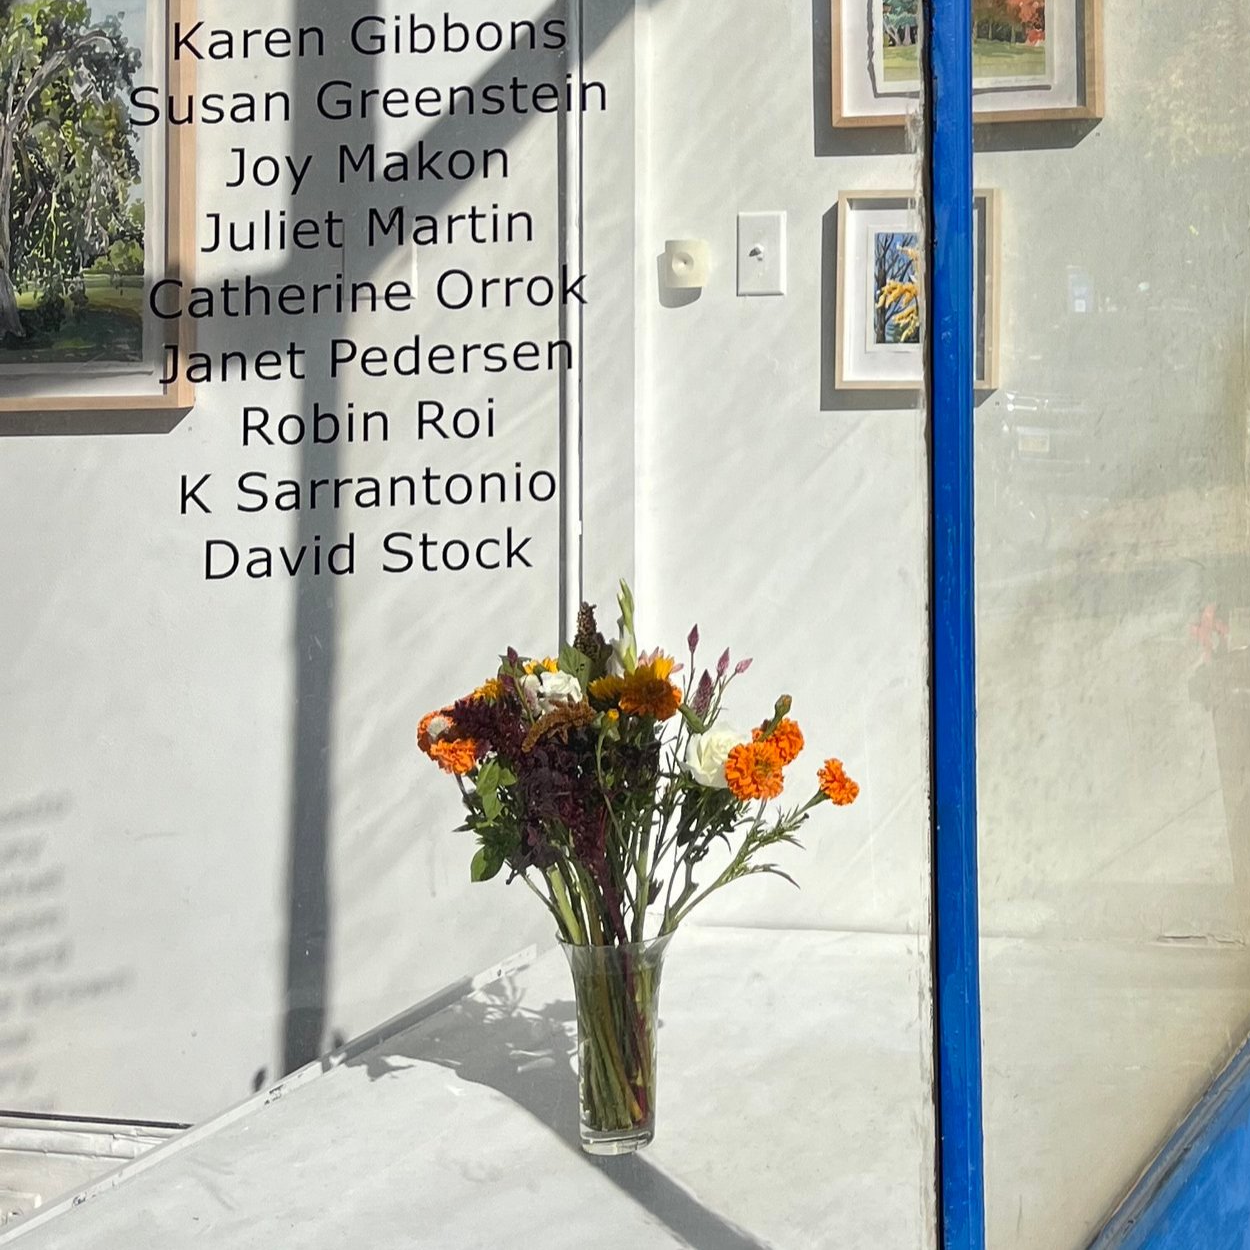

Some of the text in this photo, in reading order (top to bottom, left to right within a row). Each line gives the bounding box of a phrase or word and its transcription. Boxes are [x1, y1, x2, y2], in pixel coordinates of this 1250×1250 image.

[174, 13, 566, 60] Karen Gibbons
[129, 74, 606, 126] Susan Greenstein
[226, 140, 508, 196] Joy Makon
[201, 205, 532, 252] Juliet Martin
[149, 264, 588, 320] Catherine Orrok
[159, 335, 572, 384] Janet Pedersen
[243, 398, 496, 446] Robin Roi
[181, 462, 556, 514] K Sarrantonio
[205, 526, 531, 580] David Stock
